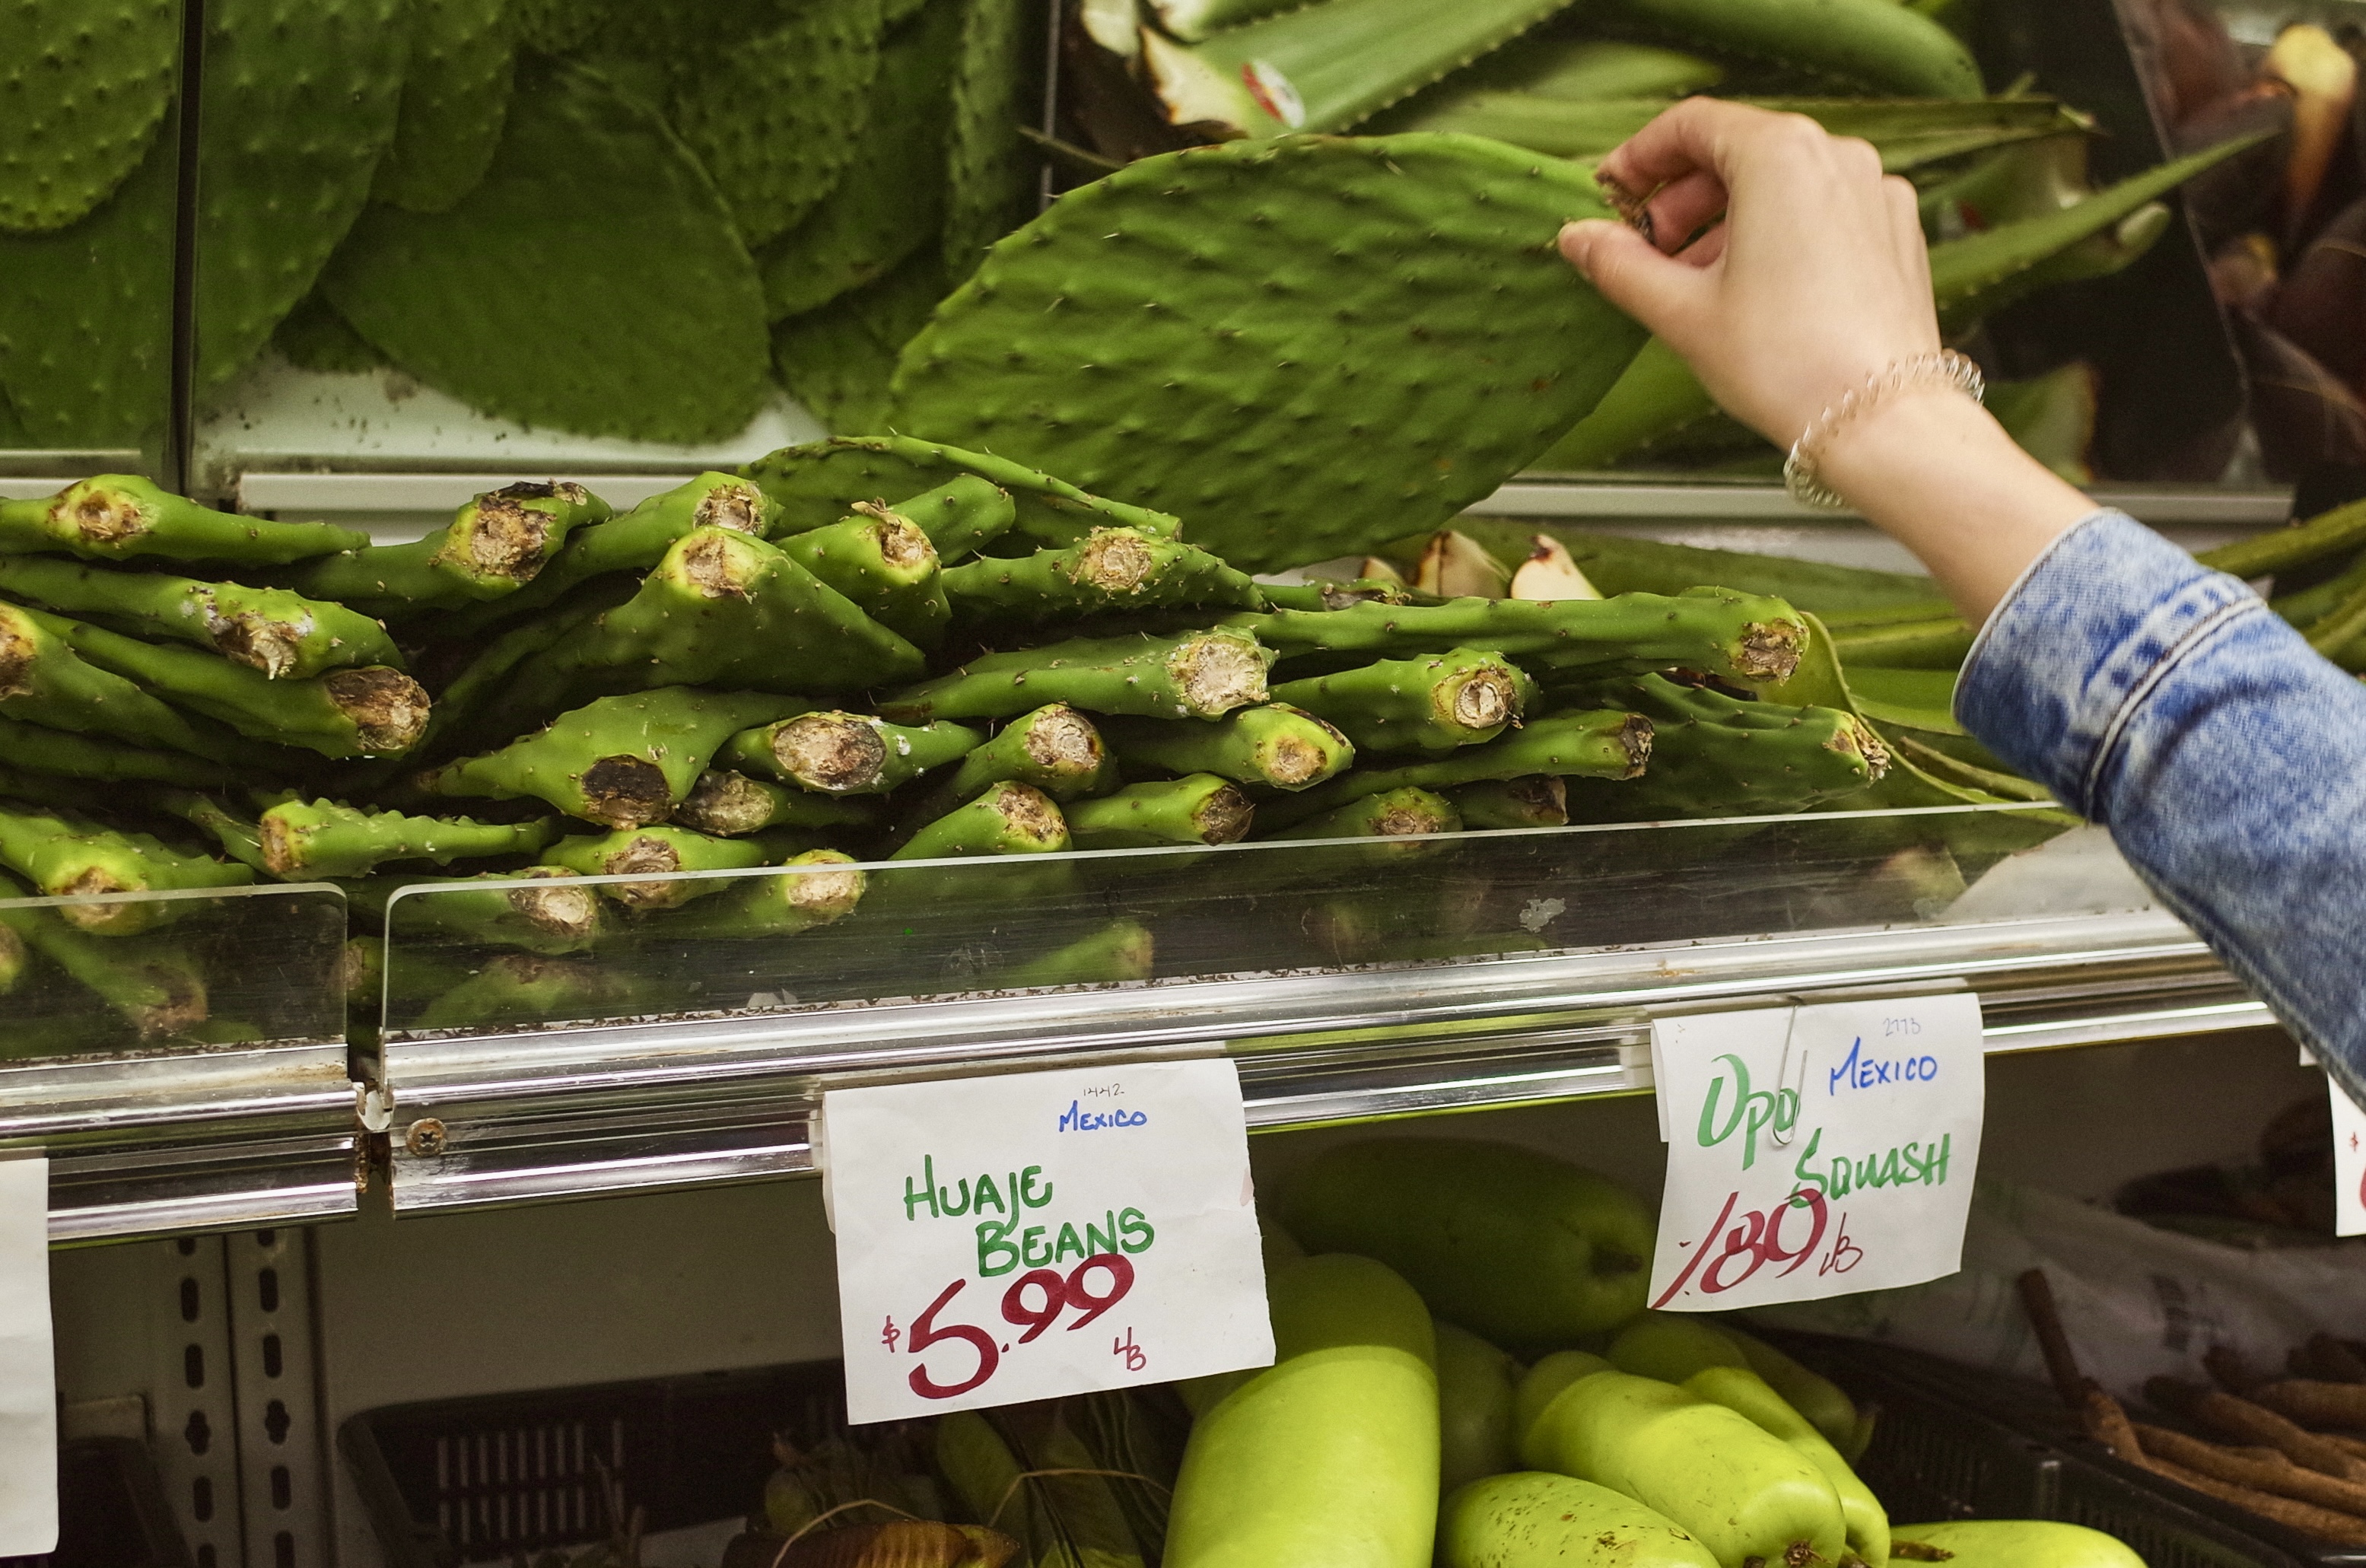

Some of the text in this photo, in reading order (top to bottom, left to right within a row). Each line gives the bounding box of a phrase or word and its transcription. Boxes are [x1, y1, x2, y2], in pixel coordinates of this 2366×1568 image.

[1083, 1083, 1125, 1097] 1442
[1829, 1035, 1938, 1096] MEXICO
[1059, 1099, 1147, 1132] MEXICO
[903, 1154, 1053, 1236] HUAJE
[1789, 1127, 1951, 1209] SQUASH
[975, 1207, 1155, 1277] BEANS
